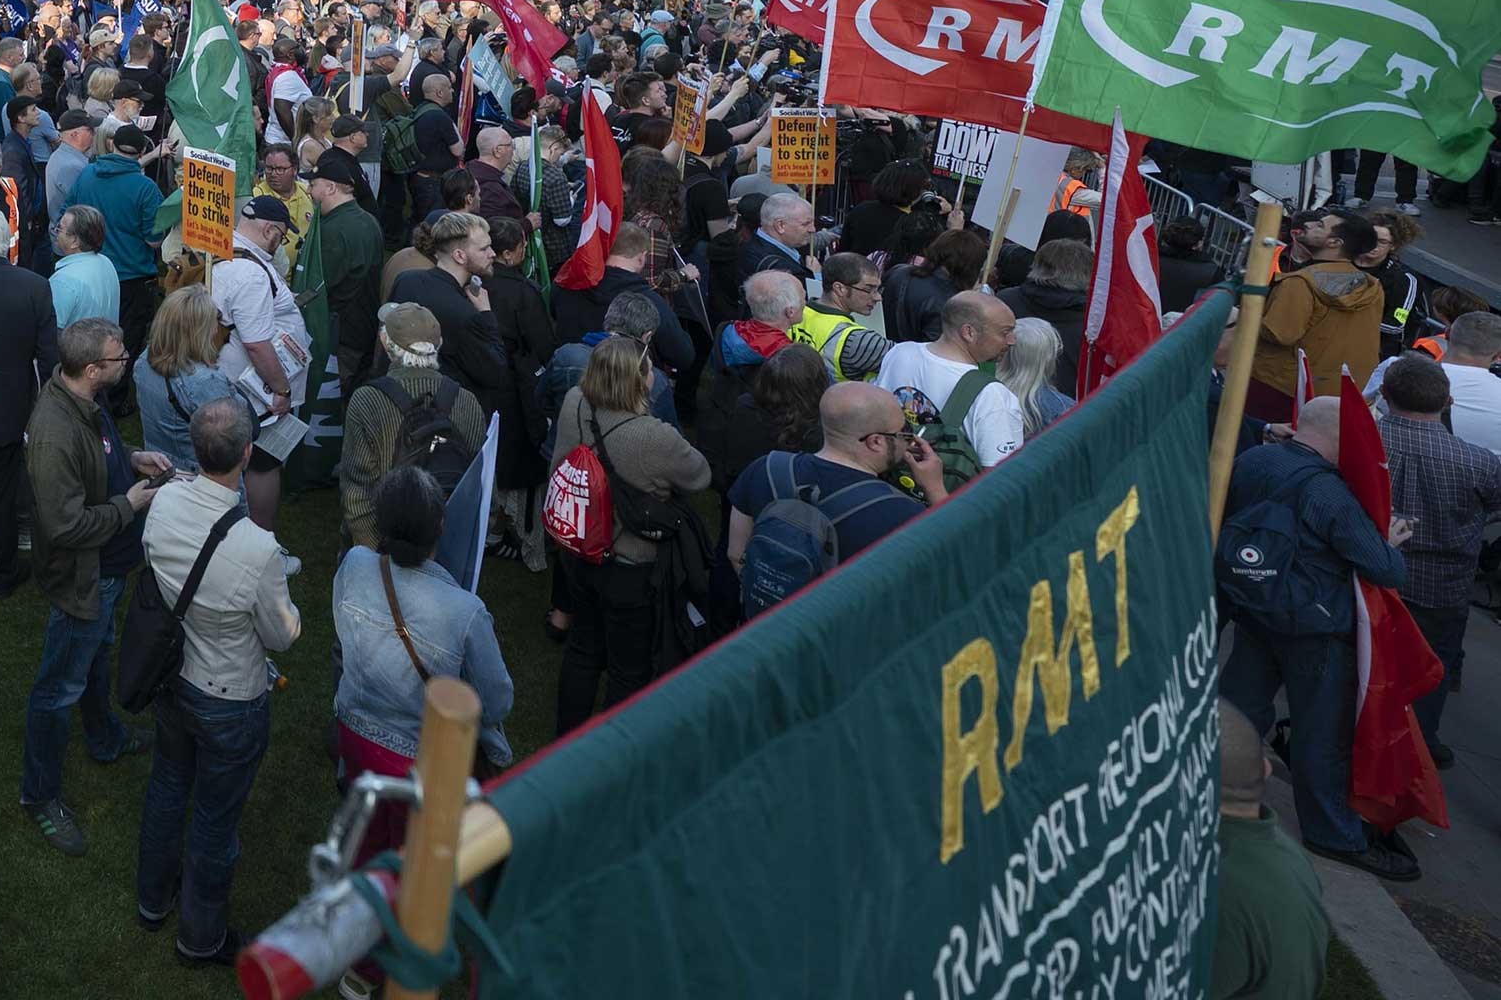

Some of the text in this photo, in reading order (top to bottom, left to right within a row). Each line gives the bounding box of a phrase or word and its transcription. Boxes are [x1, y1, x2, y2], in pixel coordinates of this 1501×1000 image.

[917, 5, 1043, 68] RM
[1162, 1, 1439, 99] RMT
[778, 119, 818, 132] Defend
[779, 109, 804, 117] Socialist
[777, 133, 830, 150] the right
[778, 147, 829, 160] to strike
[190, 150, 230, 168] Socialist Worker
[934, 153, 951, 169] THE
[950, 157, 987, 180] TOIES
[189, 162, 224, 188] Defend
[188, 181, 230, 209] the right
[188, 199, 229, 227] to strike
[940, 484, 1141, 865] RMT
[934, 783, 1089, 1000] TRANSPORT
